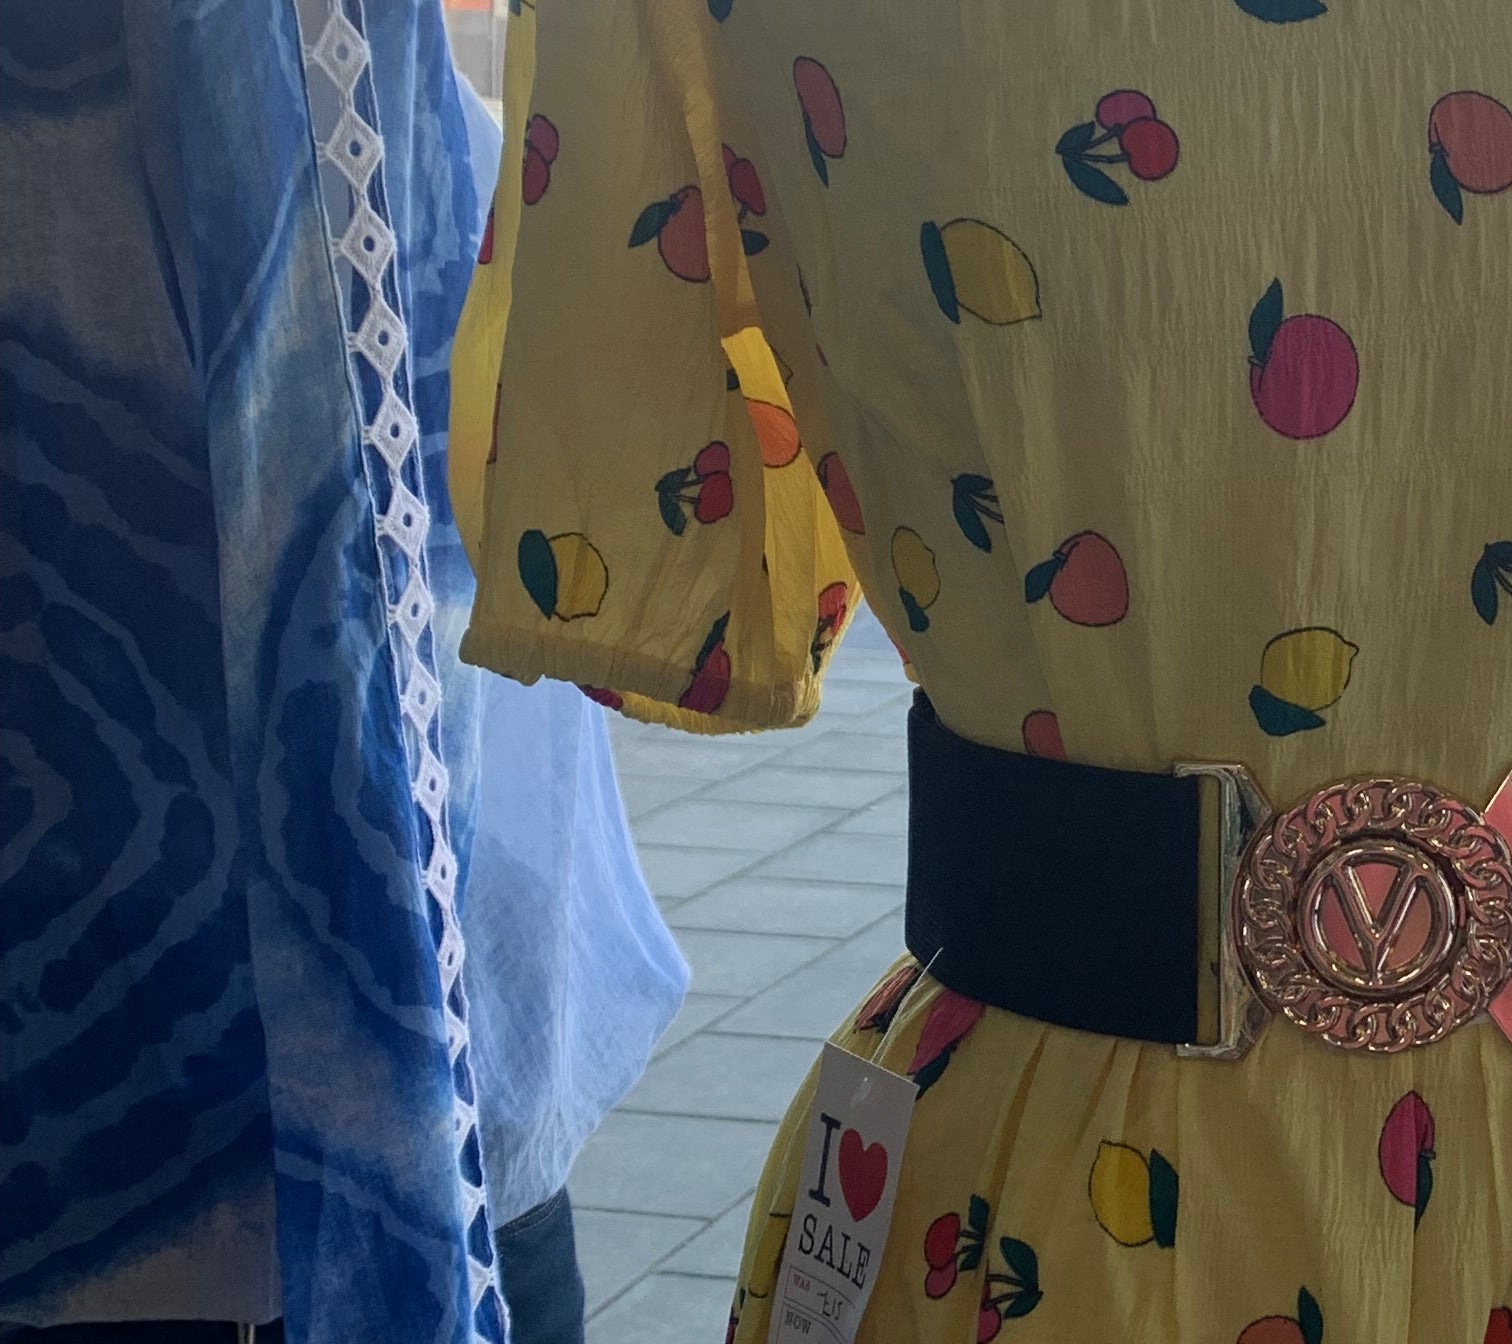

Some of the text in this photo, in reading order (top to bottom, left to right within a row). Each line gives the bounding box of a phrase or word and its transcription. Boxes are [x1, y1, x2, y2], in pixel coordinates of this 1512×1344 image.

[808, 1112, 842, 1207] I
[797, 1213, 871, 1291] SALE
[784, 1310, 813, 1336] NOW
